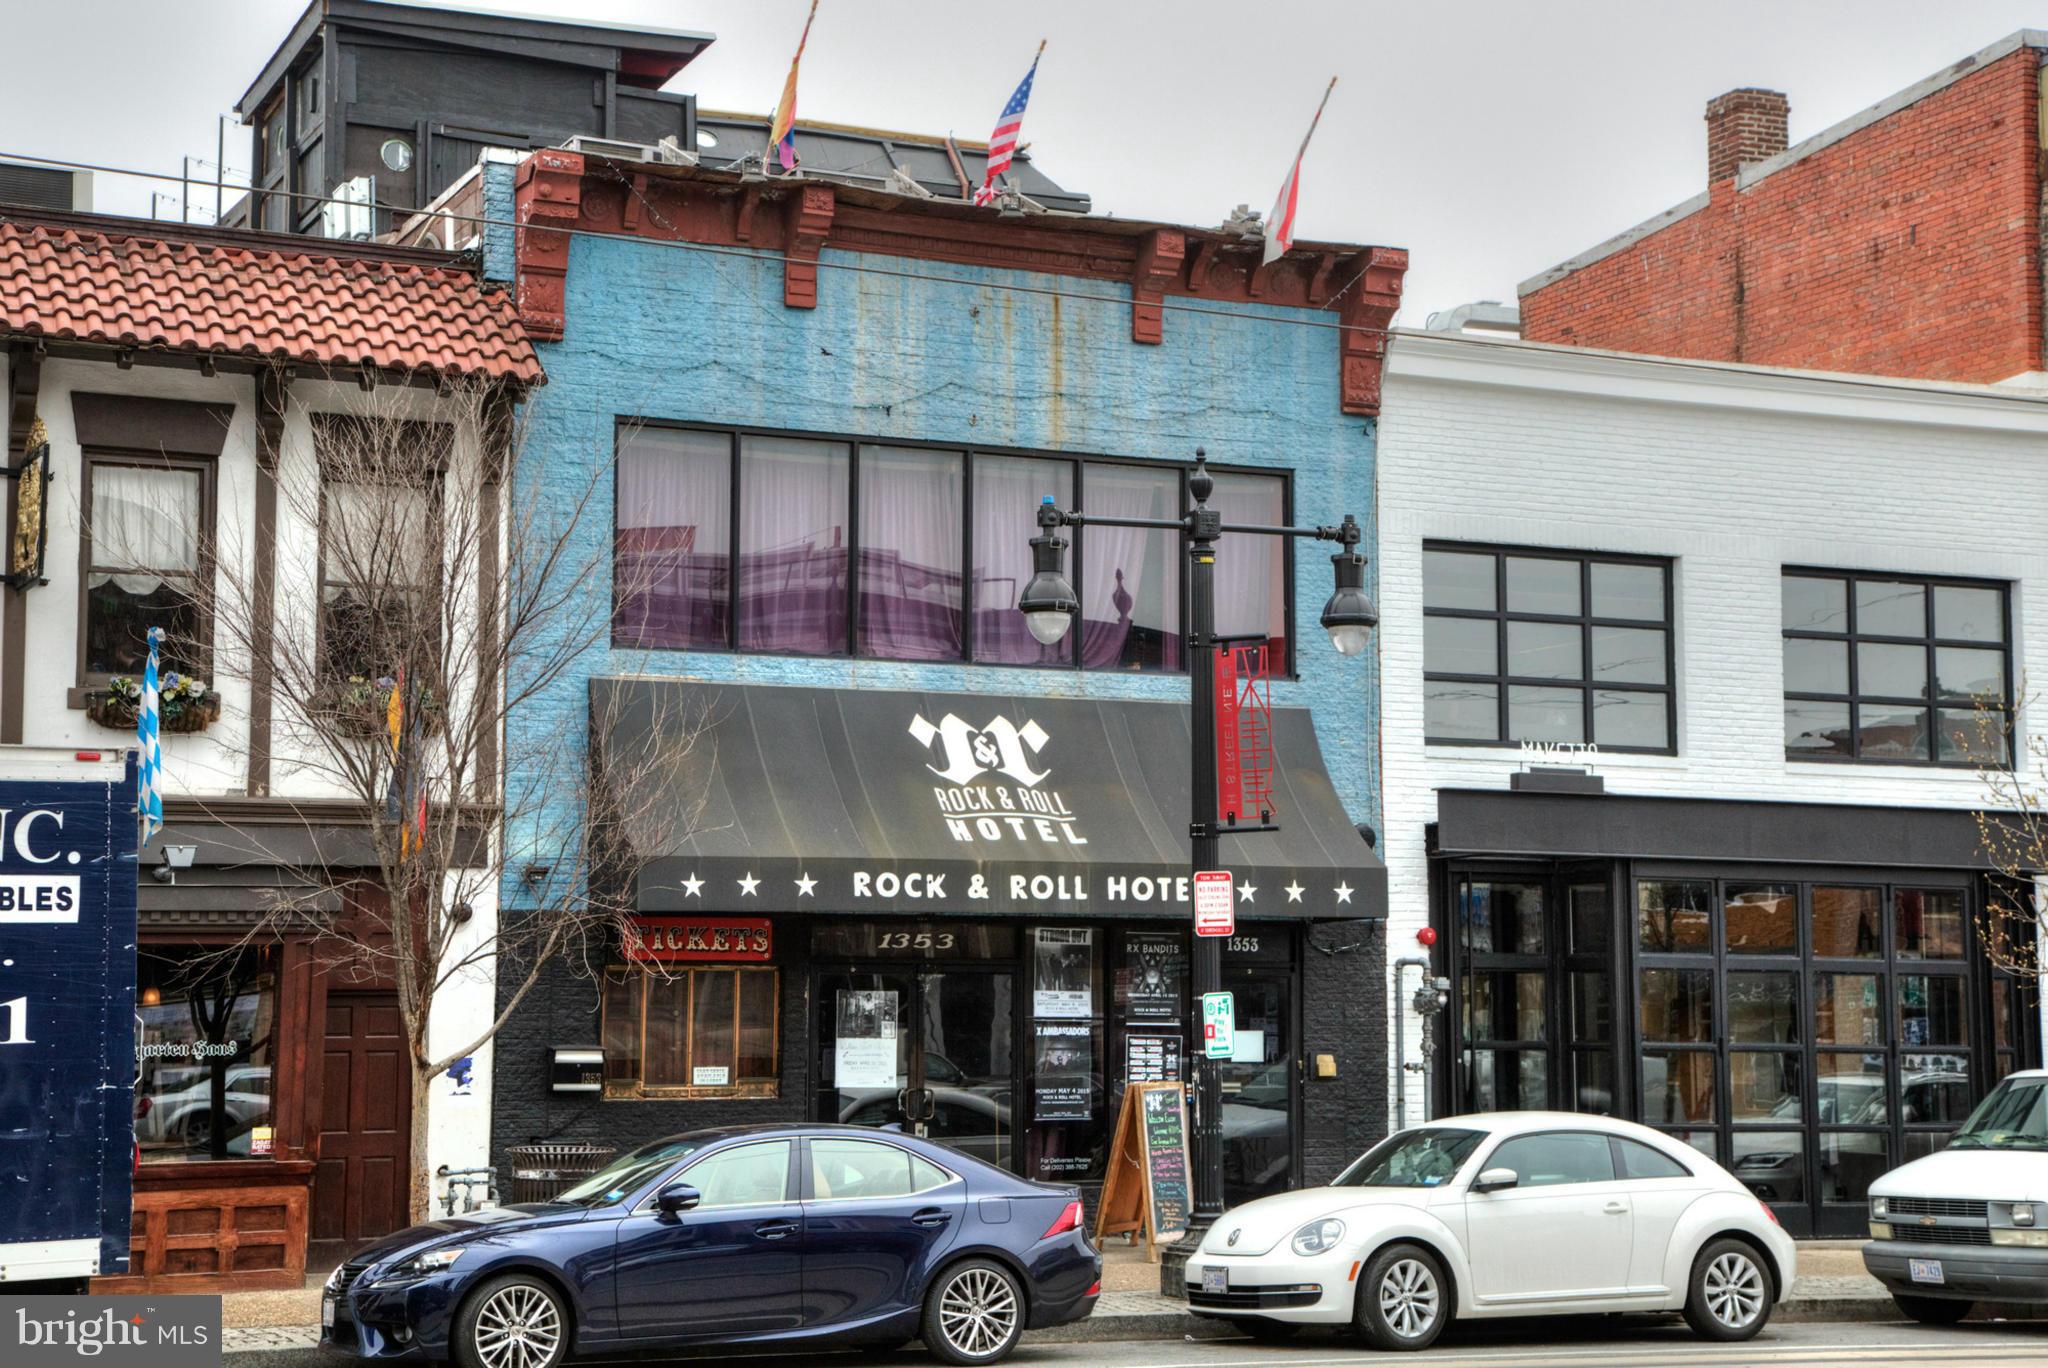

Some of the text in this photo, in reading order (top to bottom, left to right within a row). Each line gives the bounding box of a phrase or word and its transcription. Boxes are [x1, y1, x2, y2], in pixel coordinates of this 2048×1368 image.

[934, 786, 1072, 815] ROCK & ROLL
[0, 809, 81, 864] C.
[946, 817, 1088, 844] HOTEL
[853, 872, 1190, 902] ROCK & ROLL HOTE
[631, 925, 769, 952] TICKETS
[877, 933, 955, 949] 1353
[1126, 944, 1180, 954] RX BANDITS
[1227, 937, 1259, 952] 1353
[1036, 1026, 1090, 1036] X AMBASSADORS
